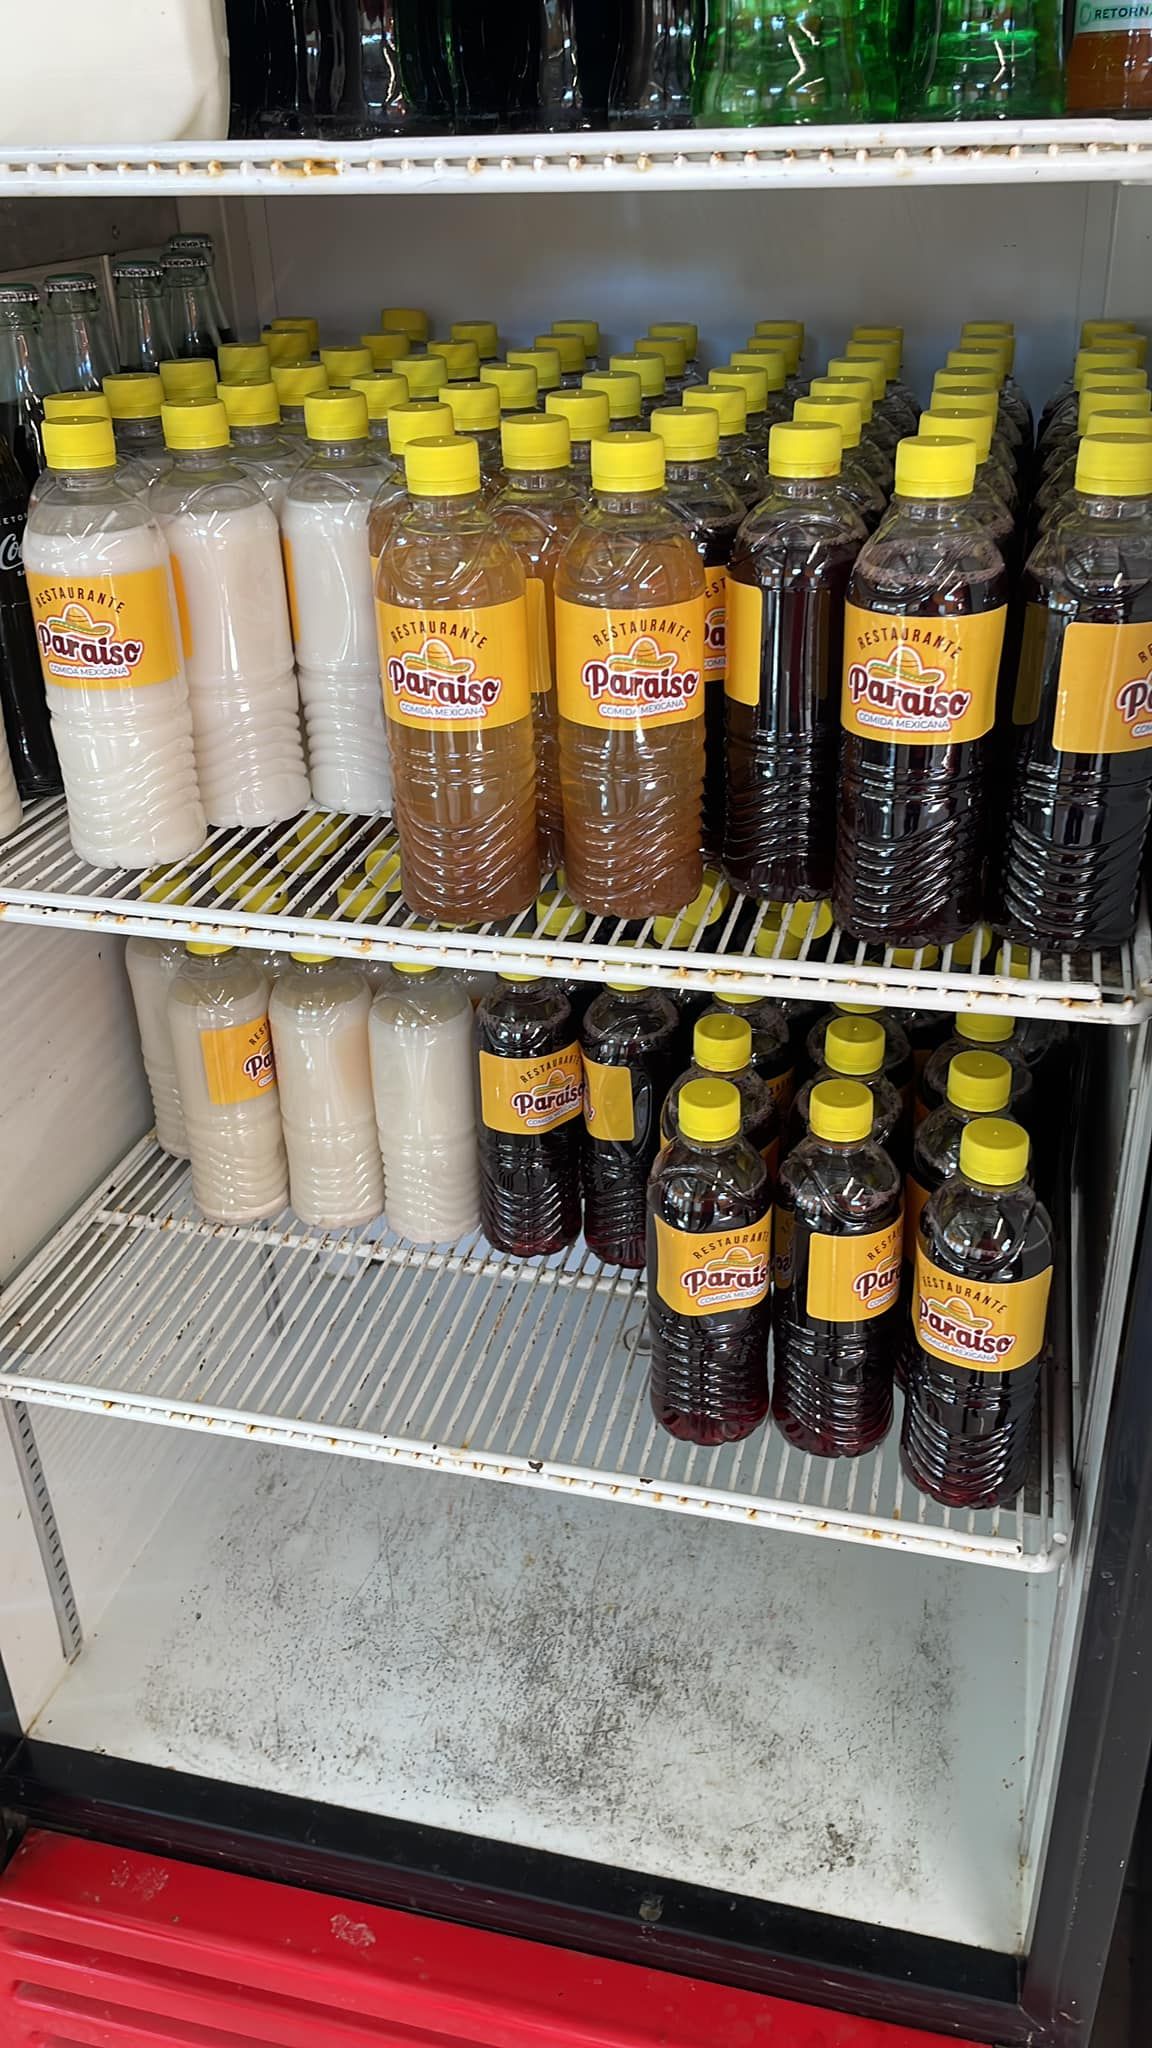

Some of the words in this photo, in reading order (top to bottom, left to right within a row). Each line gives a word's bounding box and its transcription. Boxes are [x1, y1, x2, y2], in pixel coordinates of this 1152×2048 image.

[1094, 6, 1152, 19] RETORN
[36, 587, 125, 613] RESTAURANTE
[391, 621, 487, 648] RESTAURANTE
[593, 619, 691, 646] RESTAURANTE
[857, 627, 962, 659] RESTAURANTE
[401, 703, 432, 715] COMIDA
[435, 707, 484, 716] MEXICANA
[641, 699, 684, 714] MEXICANA
[859, 713, 893, 726] COMIDA
[896, 718, 949, 729] MEXICANA
